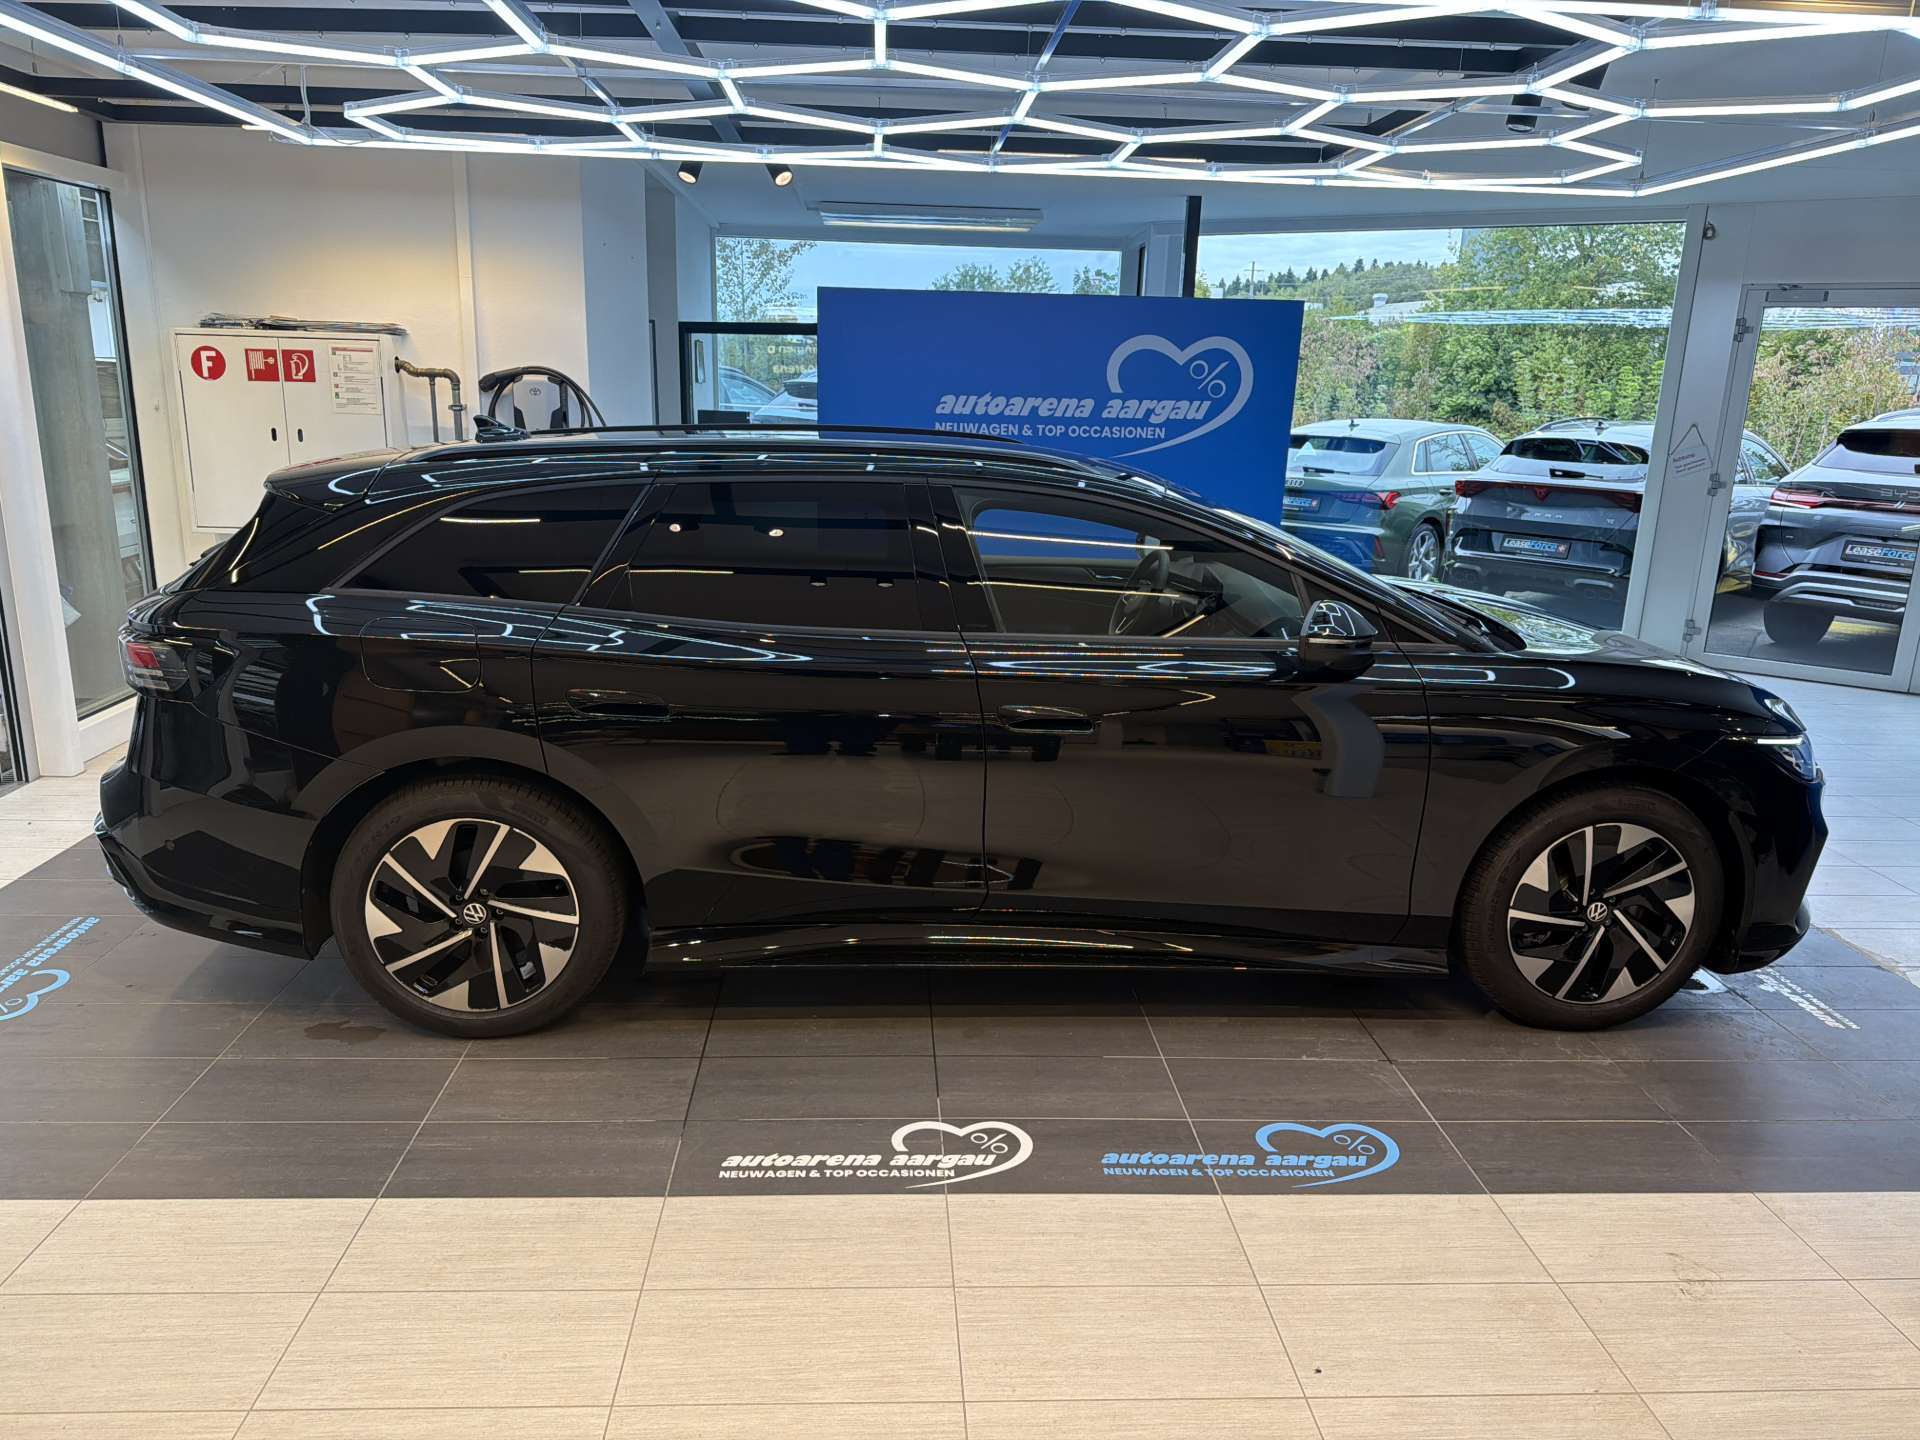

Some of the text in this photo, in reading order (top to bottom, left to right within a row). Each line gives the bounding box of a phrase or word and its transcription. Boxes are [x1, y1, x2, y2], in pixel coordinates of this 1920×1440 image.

[199, 350, 216, 377] F
[935, 392, 1213, 424] autoarena aargau
[935, 422, 1166, 439] NEUWAGEN & TOP OCCASIONEN
[1503, 538, 1558, 552] LeaseForce
[1845, 544, 1917, 561] LeaseForce
[720, 1152, 997, 1168] autoarena aargau
[1101, 1151, 1368, 1168] autoarena aargau
[719, 1169, 806, 1178] NEUWAGEN
[824, 1169, 853, 1177] TOP
[856, 1169, 955, 1177] OCCASIONEN
[1103, 1167, 1335, 1177] NEUWAGEN & TOP OCCASIONEN
